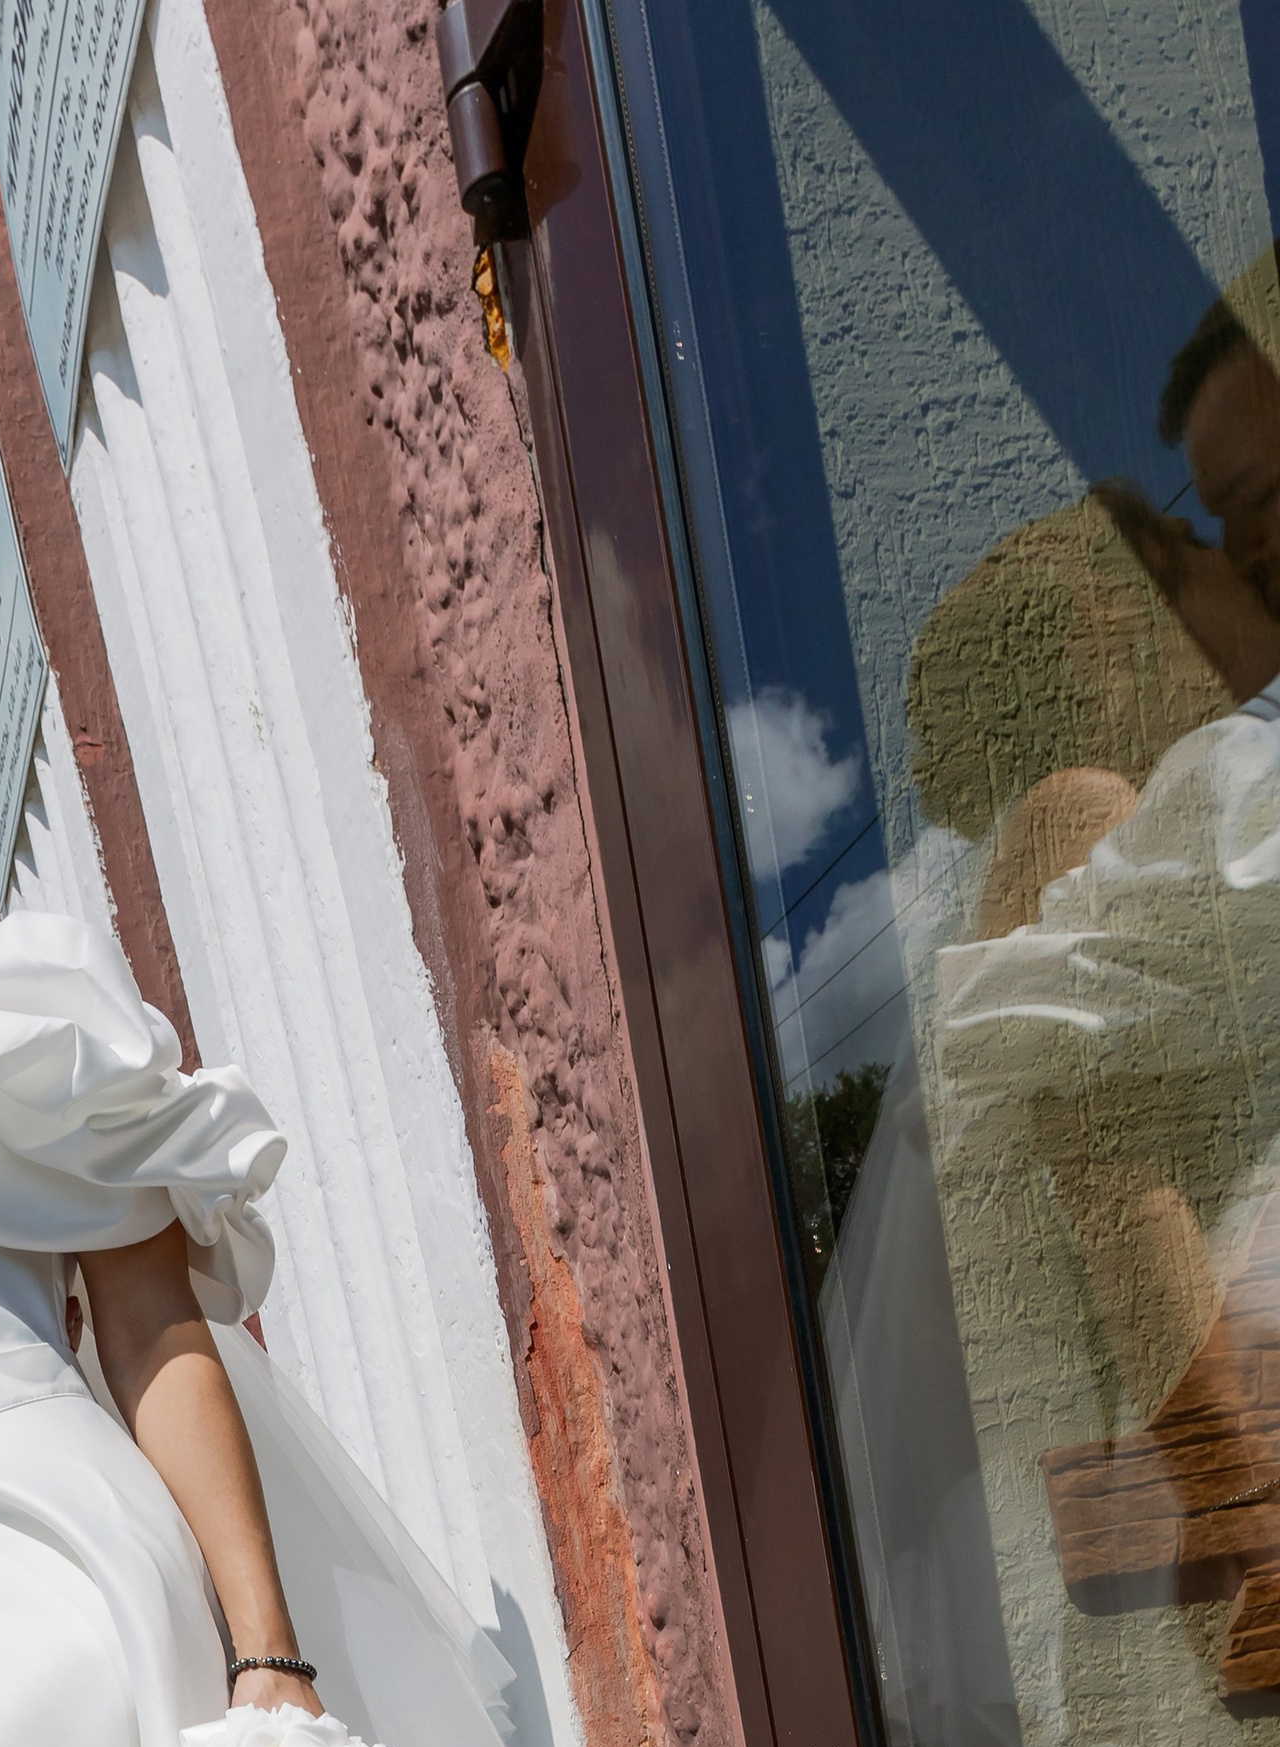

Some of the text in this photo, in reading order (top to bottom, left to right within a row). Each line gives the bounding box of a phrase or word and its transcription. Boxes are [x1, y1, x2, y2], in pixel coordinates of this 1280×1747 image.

[44, 180, 57, 272] РЕЖИМ
[52, 76, 72, 191] РАБОТЫ:
[55, 164, 74, 282] ПЕРЕРЫВ:
[74, 150, 97, 262] СУББОТА,
